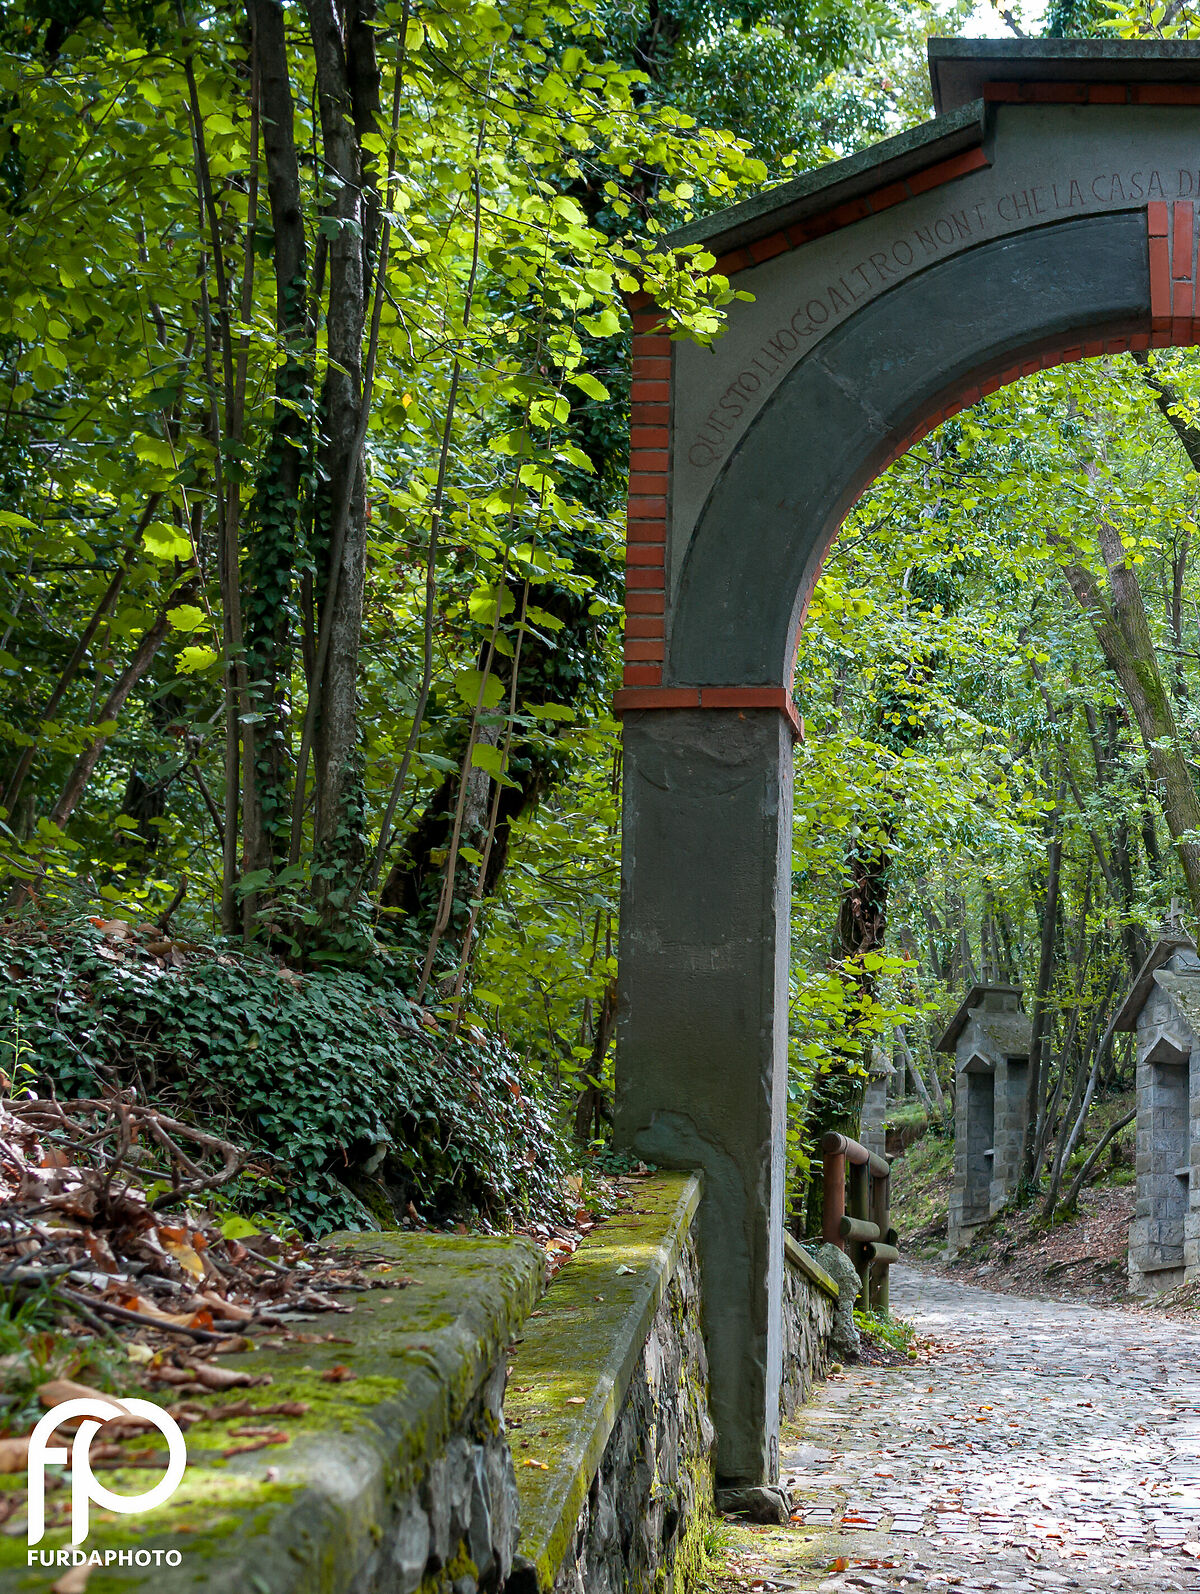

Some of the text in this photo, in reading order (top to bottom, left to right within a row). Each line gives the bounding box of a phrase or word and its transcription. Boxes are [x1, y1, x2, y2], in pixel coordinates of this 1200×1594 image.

[688, 371, 761, 468] QUESTO
[752, 298, 830, 377] LUOGO
[826, 239, 914, 315] ALTRO
[914, 212, 972, 255] NON
[997, 187, 1047, 222] CHE
[1053, 179, 1085, 209] LA
[1092, 170, 1164, 202] CASA
